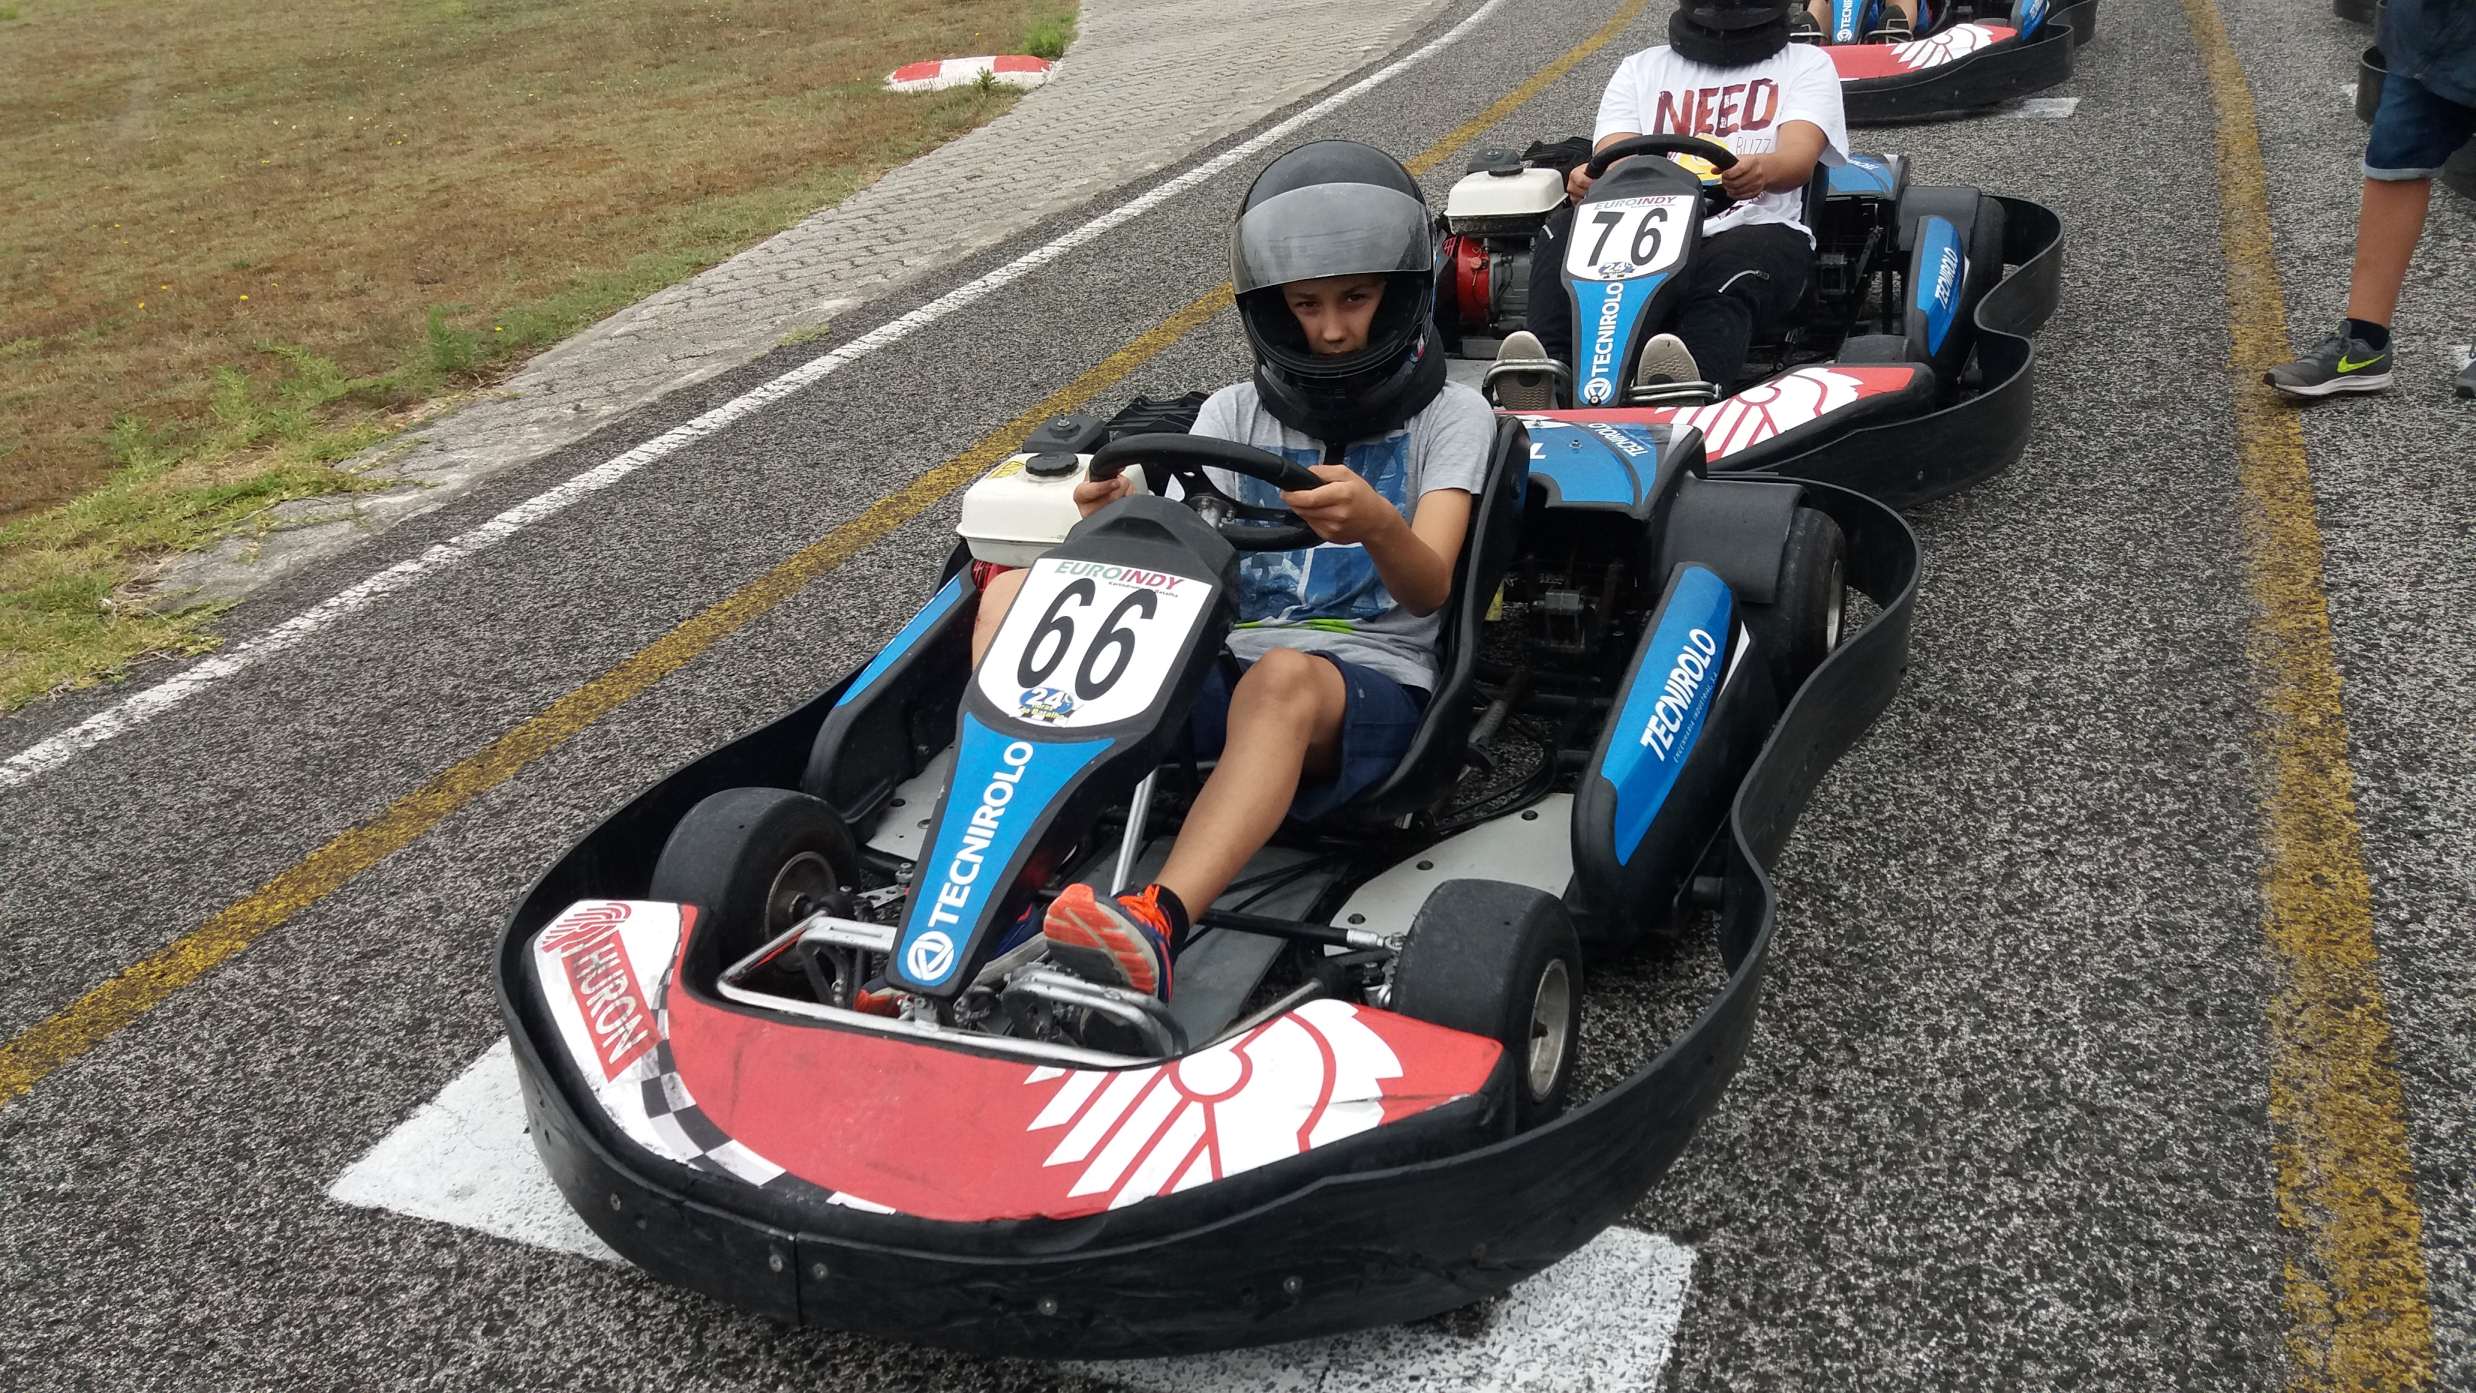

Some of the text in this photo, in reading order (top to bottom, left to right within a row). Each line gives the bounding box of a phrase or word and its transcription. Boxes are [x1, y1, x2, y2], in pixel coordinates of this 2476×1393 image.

[1653, 78, 1779, 137] NEED
[1593, 196, 1678, 211] EUROINDY
[1587, 207, 1668, 267] 76
[1934, 246, 1959, 310] TECNIROLO
[1591, 281, 1625, 378] TECNIROLO
[1587, 422, 1649, 458] TECNIROLO
[1054, 561, 1185, 590] EUROINDY
[1017, 577, 1158, 701] 66
[1640, 627, 1716, 762] TECNIROLO
[927, 740, 1034, 928] TECNIROLO
[575, 942, 650, 1065] HURON
